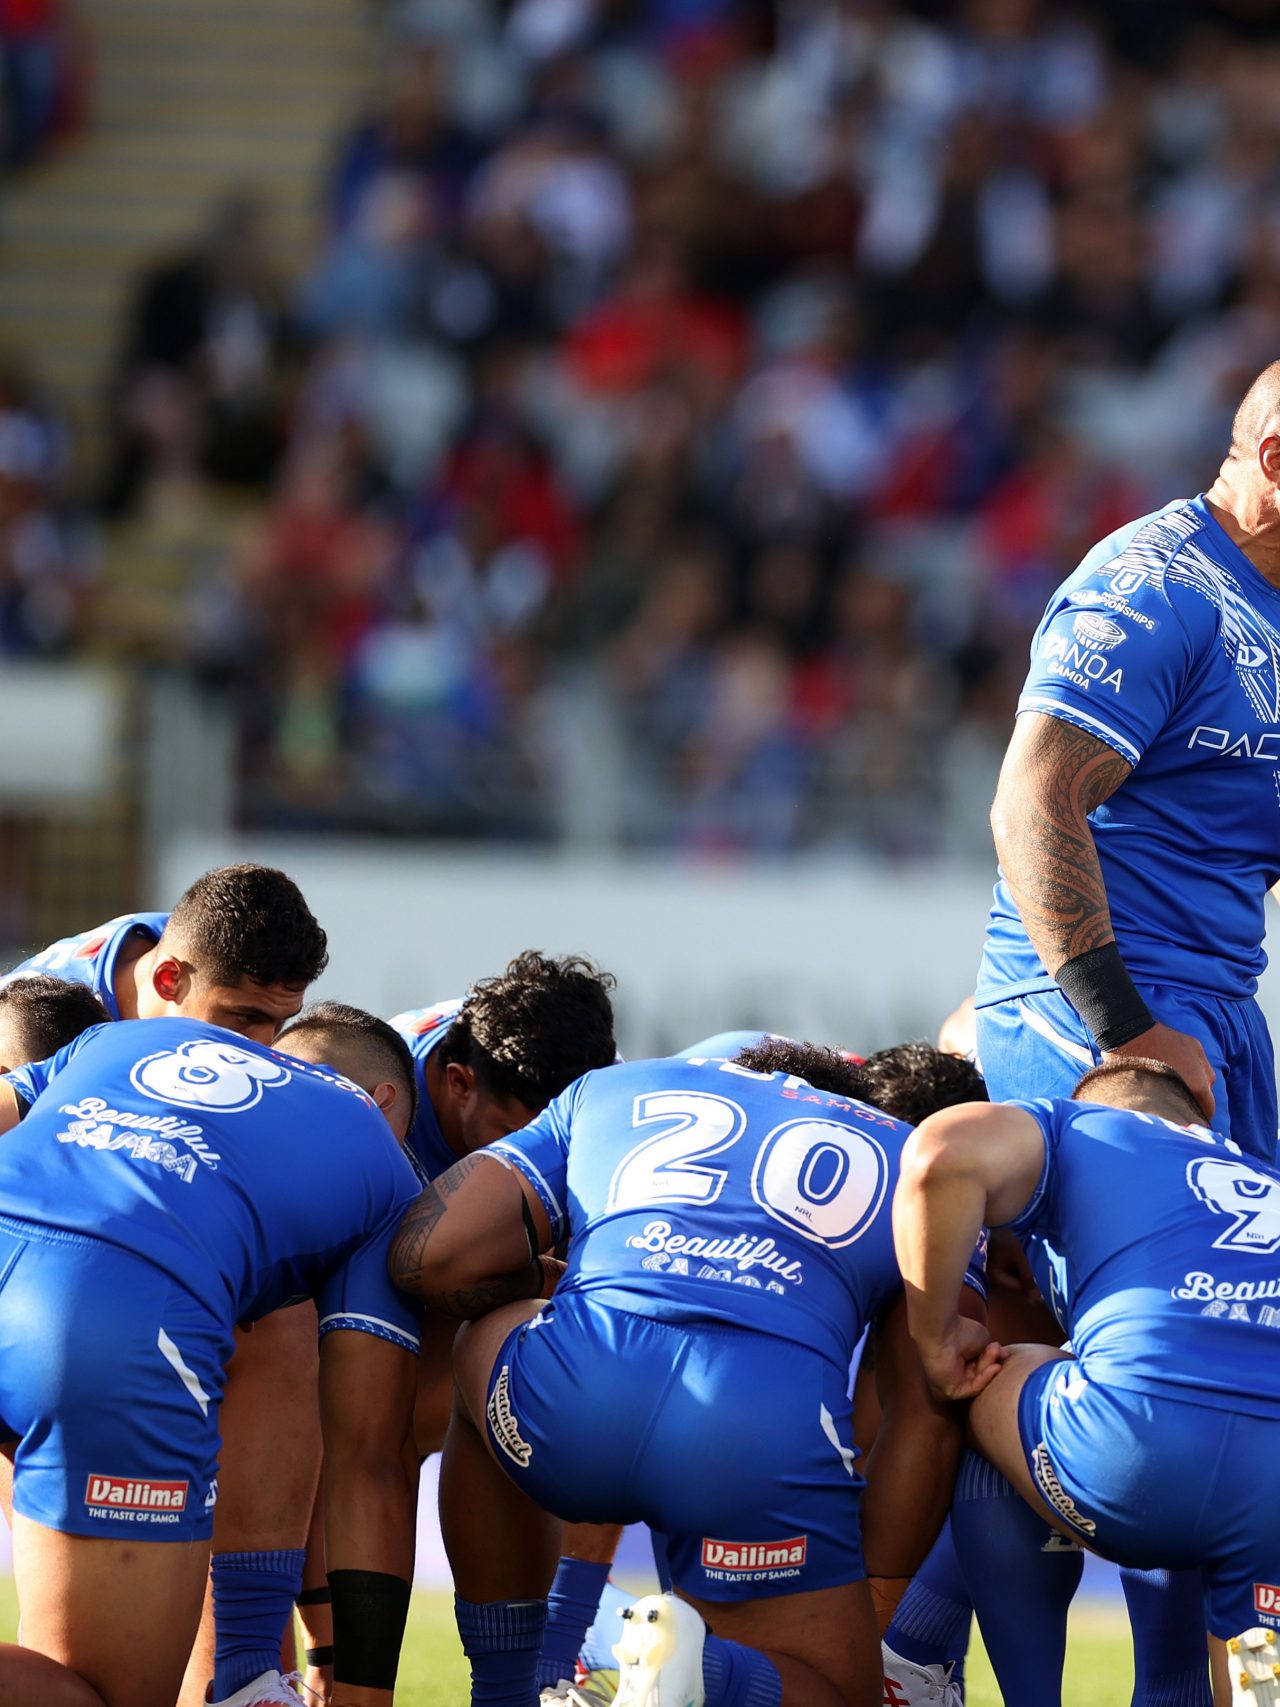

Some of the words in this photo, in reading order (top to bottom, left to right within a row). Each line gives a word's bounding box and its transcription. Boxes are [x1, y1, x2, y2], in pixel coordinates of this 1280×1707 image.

[1047, 661, 1091, 690] SAMOA
[1235, 665, 1268, 674] DYNASTY
[129, 1039, 291, 1113] 8
[780, 1089, 897, 1131] SAMOA
[58, 1097, 221, 1171] Beautiful
[57, 1120, 198, 1184] SAMOA
[604, 1089, 889, 1250] 20
[625, 1220, 802, 1284] Beautiful
[91, 1480, 185, 1507] Vailima
[89, 1508, 106, 1519] THE
[108, 1510, 134, 1521] TASTE
[136, 1513, 149, 1522] OF
[150, 1514, 179, 1523] SAMOA
[706, 1543, 803, 1566] Vailima
[705, 1569, 724, 1580] THE
[725, 1572, 752, 1582] TASTE
[754, 1571, 767, 1580] OF
[768, 1568, 800, 1579] SAMOA
[1258, 1614, 1275, 1626] THE
